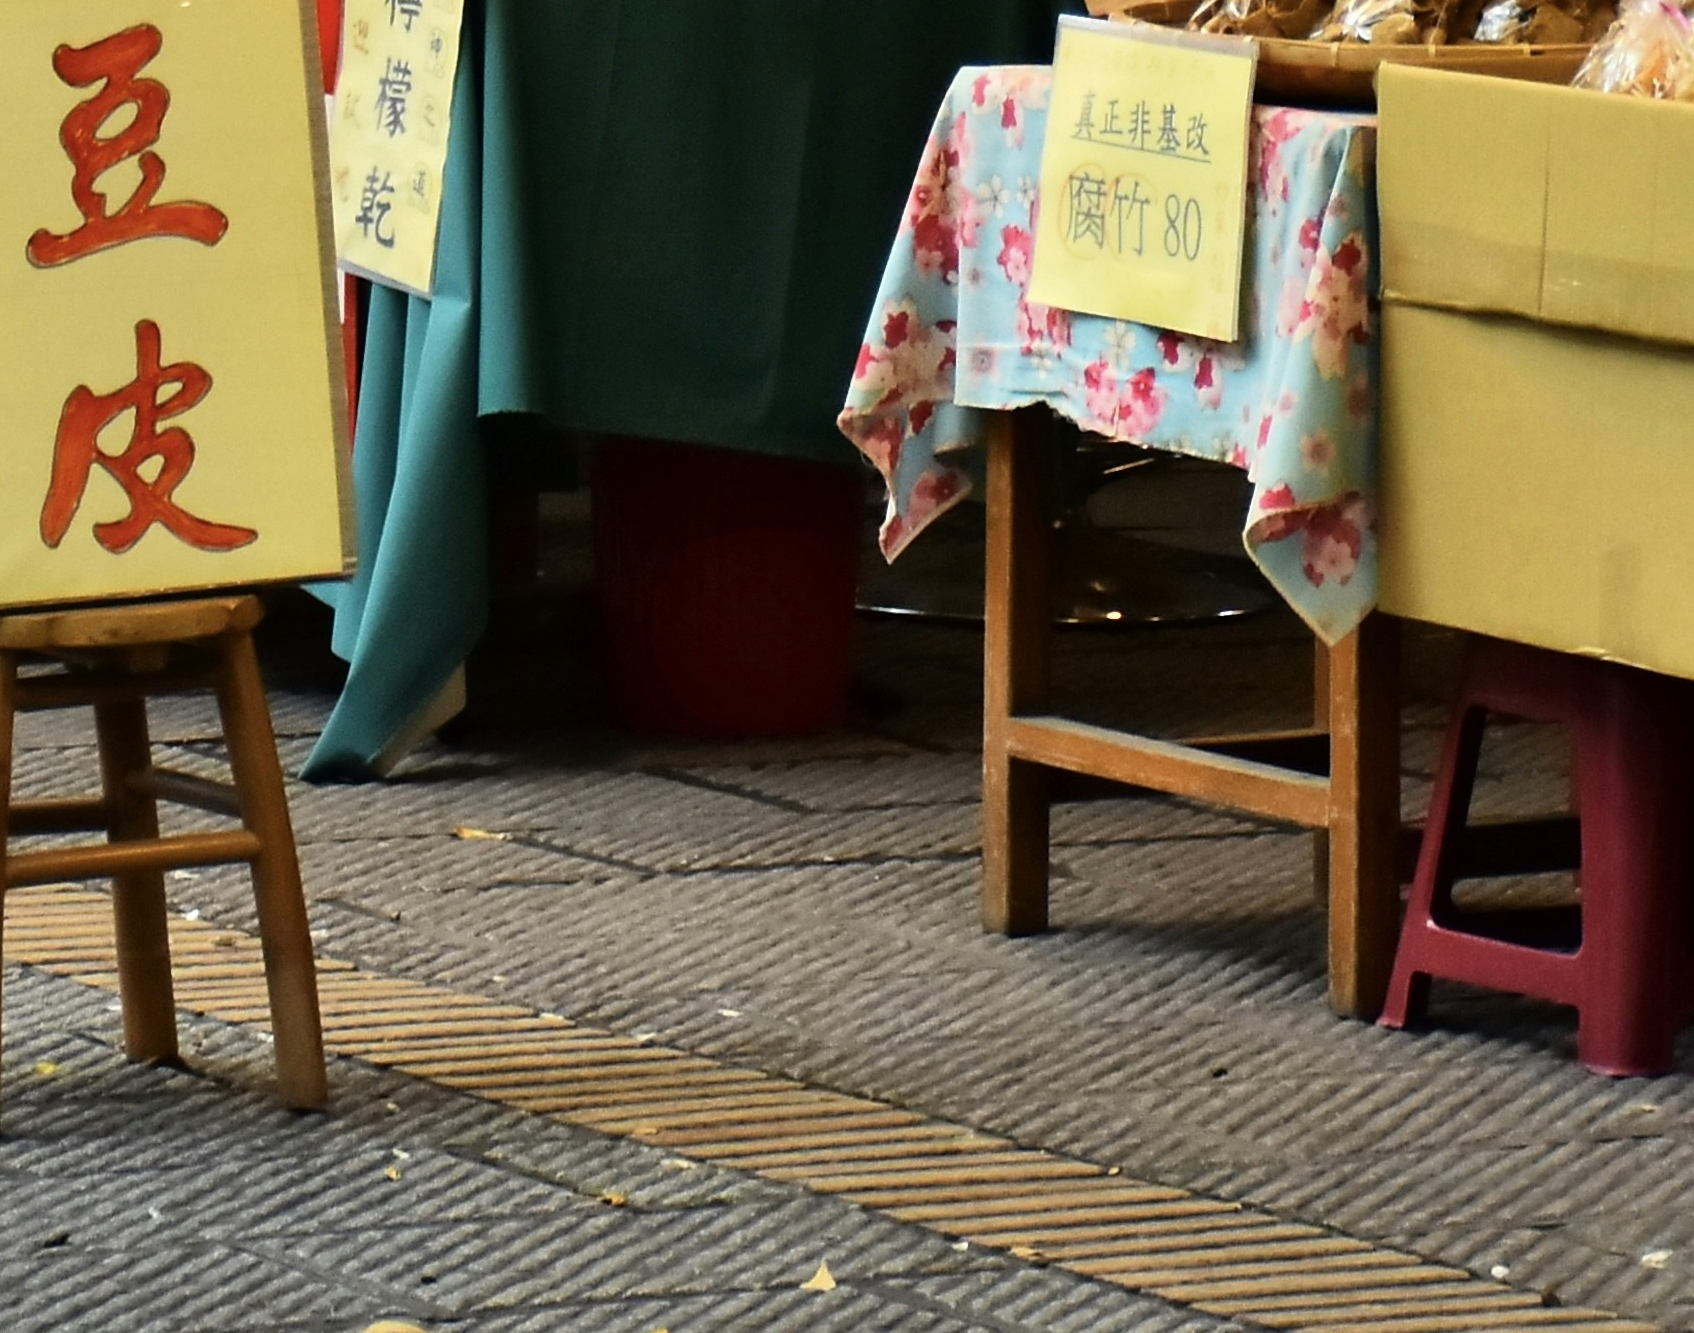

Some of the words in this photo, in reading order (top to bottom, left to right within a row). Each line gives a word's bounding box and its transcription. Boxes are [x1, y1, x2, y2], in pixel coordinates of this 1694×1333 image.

[1074, 89, 1210, 156] 真正非基改
[1066, 171, 1151, 256] 腐竹
[1163, 193, 1202, 261] 80
